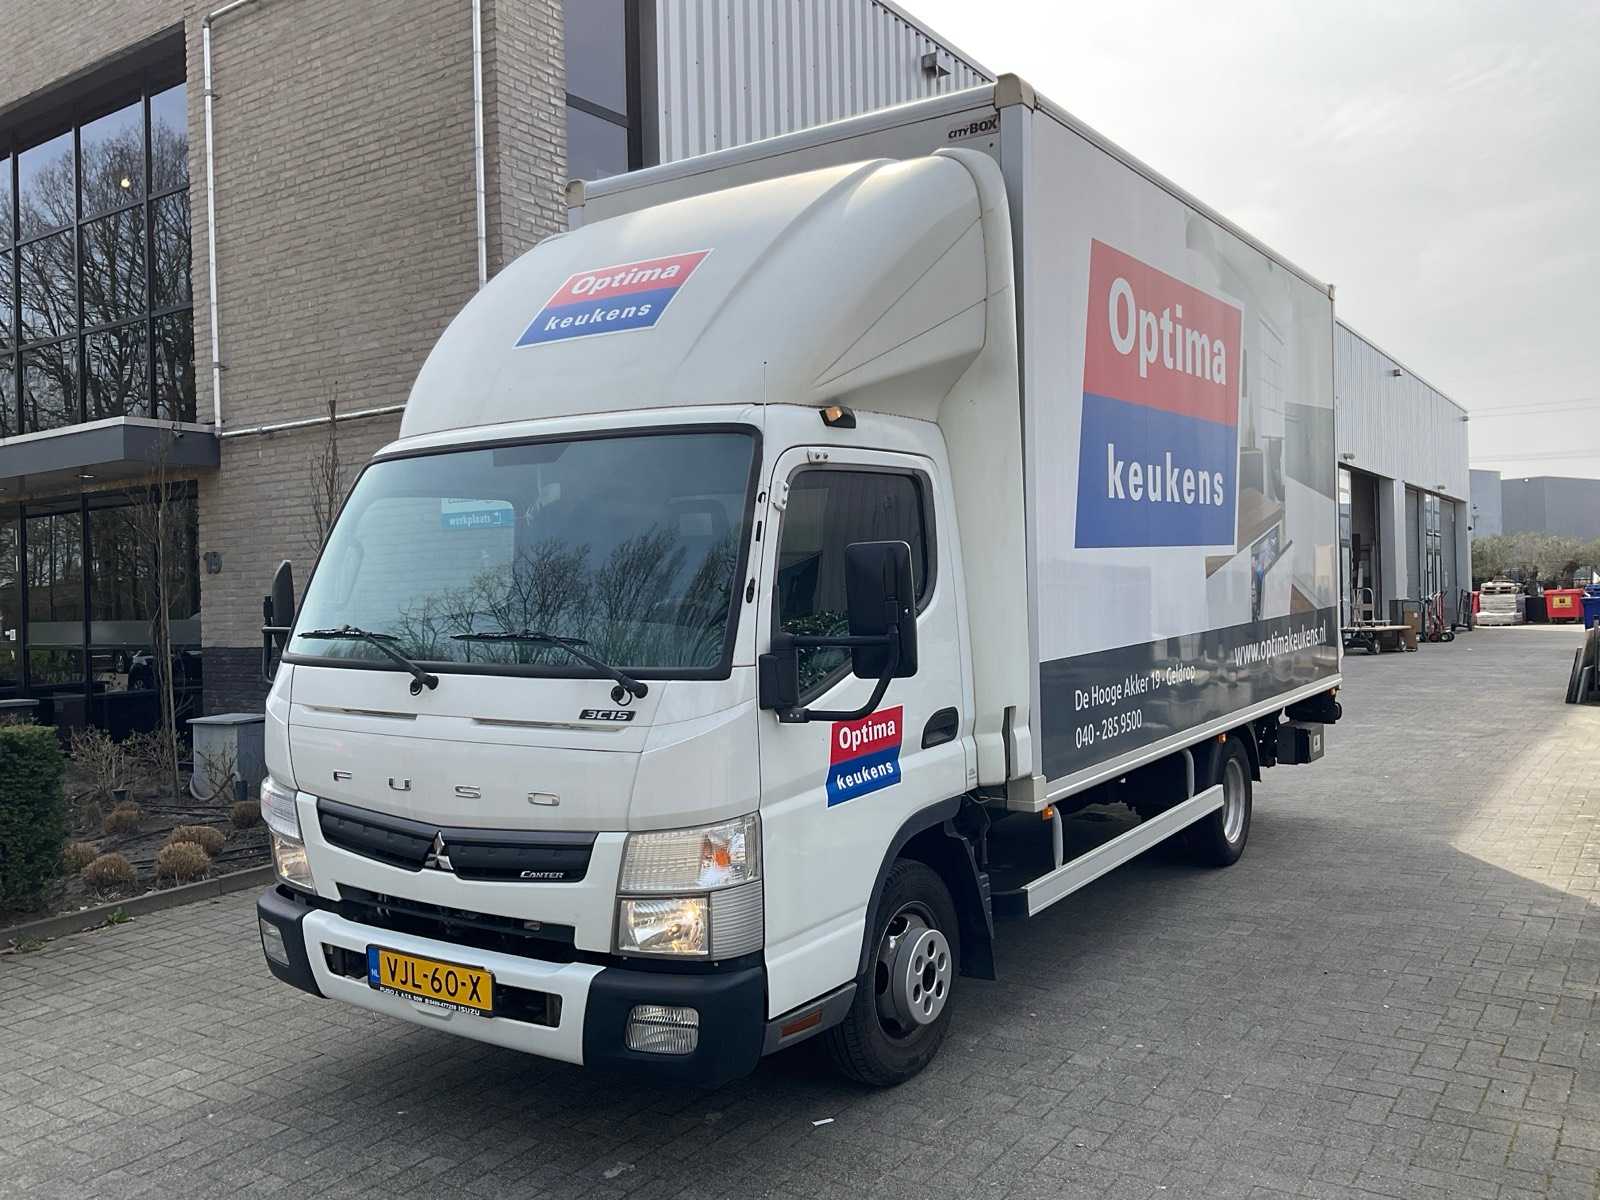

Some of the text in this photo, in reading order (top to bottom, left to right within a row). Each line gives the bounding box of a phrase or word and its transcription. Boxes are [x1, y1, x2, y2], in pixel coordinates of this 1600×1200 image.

[571, 264, 681, 296] Optima
[543, 303, 652, 332] keukens
[1108, 277, 1227, 386] Optima
[1107, 442, 1225, 507] keukens
[1234, 619, 1327, 667] www.optimakeukens.nl
[1074, 689, 1089, 711] De
[1091, 683, 1122, 707] Hooge
[1123, 674, 1149, 698] Akker
[1151, 670, 1161, 690] 19
[1166, 664, 1196, 687] Geldrop
[584, 710, 629, 721] 3C15
[1075, 725, 1095, 749] 040
[1101, 719, 1119, 741] 285
[1120, 708, 1142, 737] 9500
[839, 720, 896, 752] Optima
[332, 769, 561, 807] FUSO
[836, 761, 894, 791] keukens
[371, 968, 380, 978] NL
[386, 956, 482, 1003] VJL-60-X
[458, 1006, 480, 1016] ISUZU
